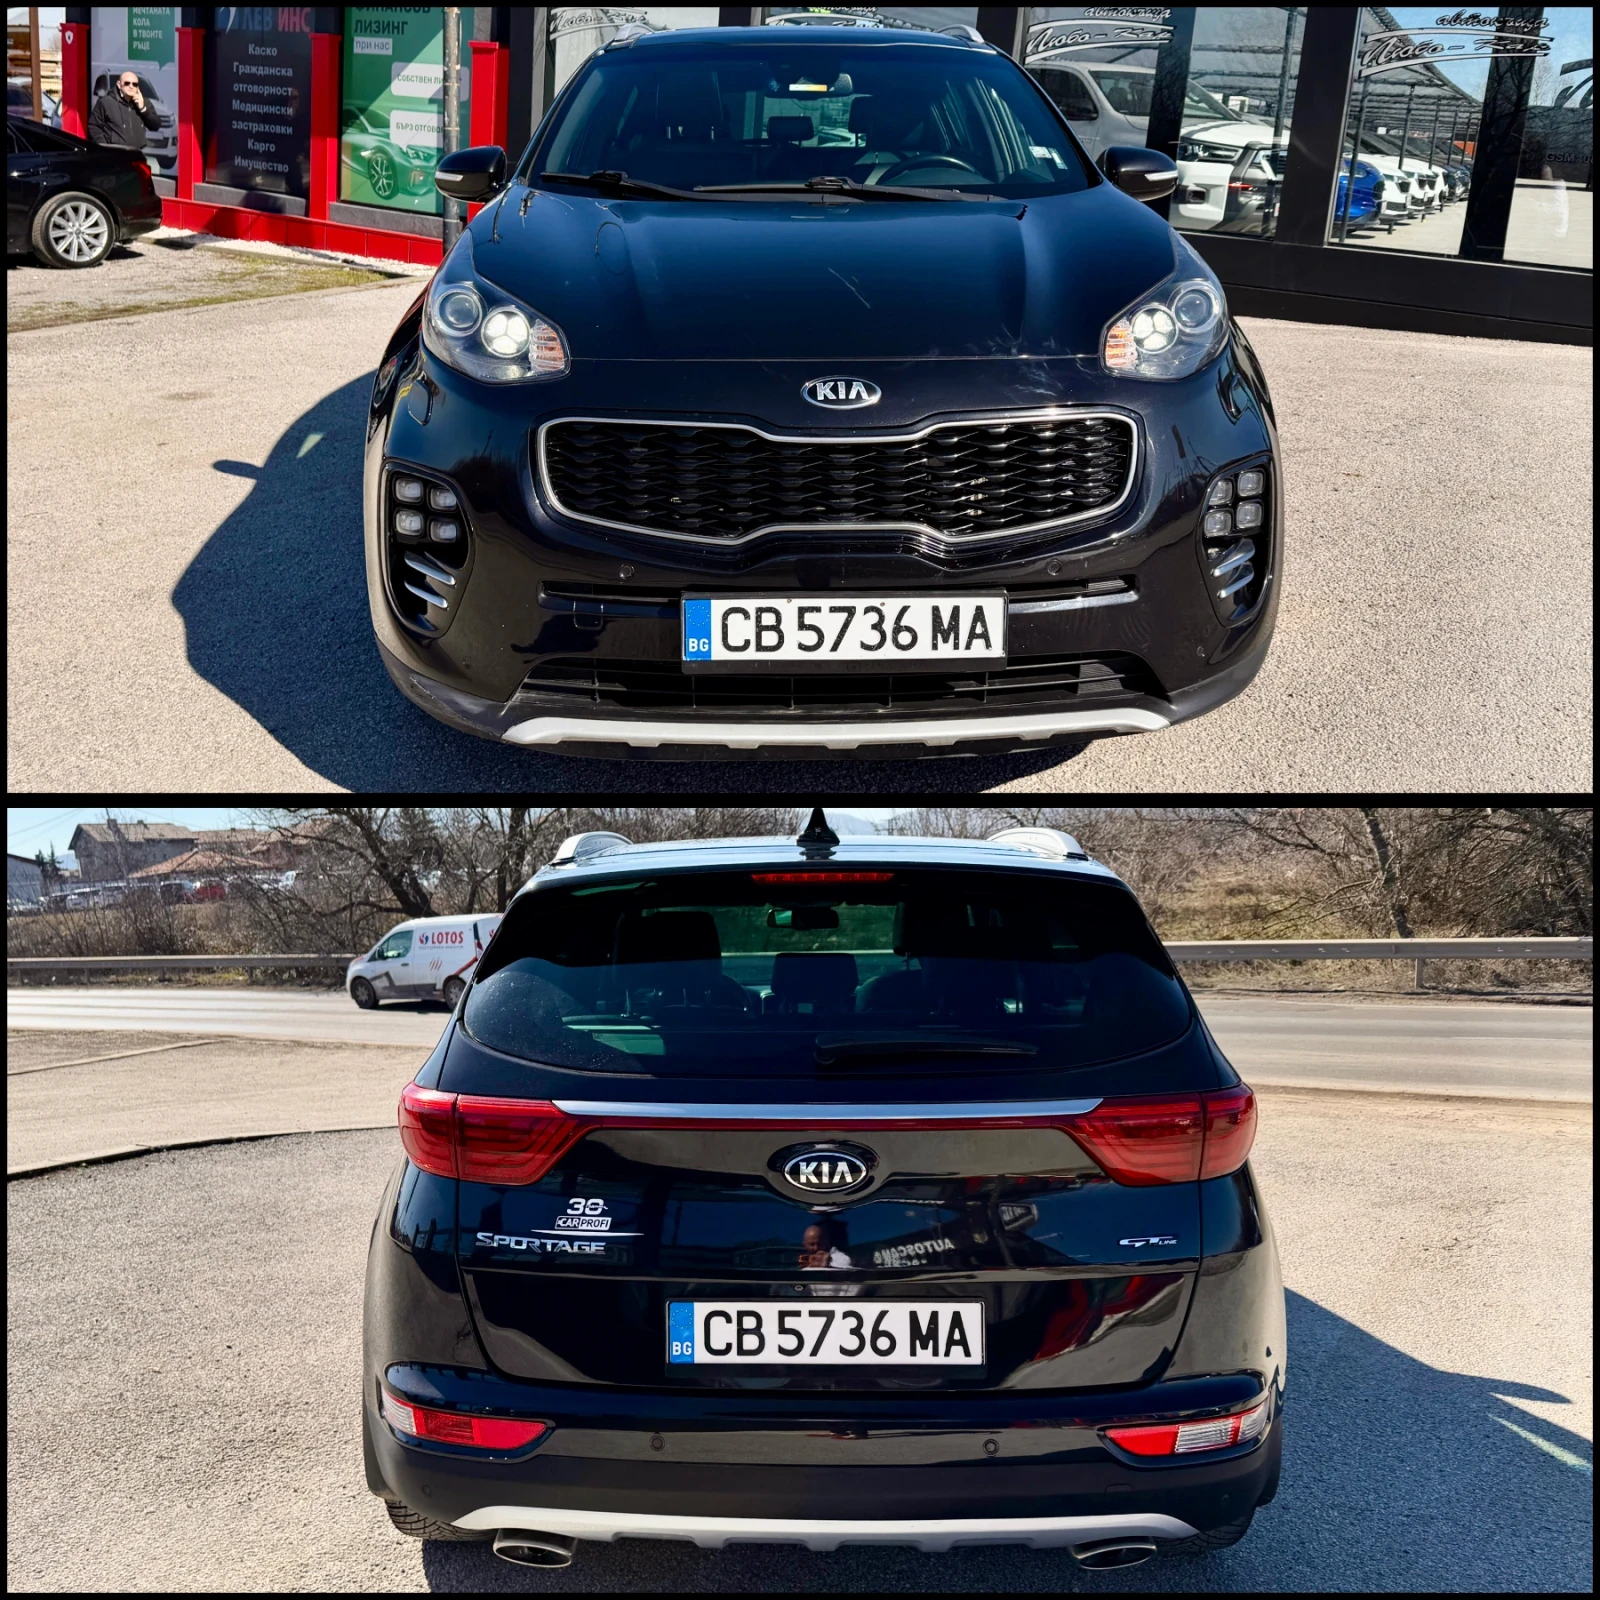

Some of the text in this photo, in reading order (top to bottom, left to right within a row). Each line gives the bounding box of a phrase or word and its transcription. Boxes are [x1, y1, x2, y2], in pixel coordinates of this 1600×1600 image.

[132, 18, 150, 26] КОЛА
[241, 7, 312, 33] ЛЕВ ИНС
[354, 19, 408, 35] ЛИЗИНГ
[132, 41, 150, 51] РЪЦЕ
[248, 43, 278, 56] Каско
[355, 41, 390, 51] при нас
[233, 61, 293, 77] Гражданска
[397, 74, 433, 84] СОБСТВЕН
[233, 83, 293, 96] отговорност
[232, 99, 293, 116] Медицински
[232, 120, 293, 135] застраховки
[396, 121, 413, 131] БЪРЗ
[247, 138, 276, 153] Карго
[234, 155, 289, 172] Имущество
[816, 381, 869, 401] KIA
[688, 605, 993, 653] BG CB 5736 MA
[431, 931, 464, 945] LOTOS
[798, 1160, 854, 1185] KIA
[475, 1231, 607, 1255] SPORTAGE
[672, 1309, 972, 1358] BG CB 5736 MA
